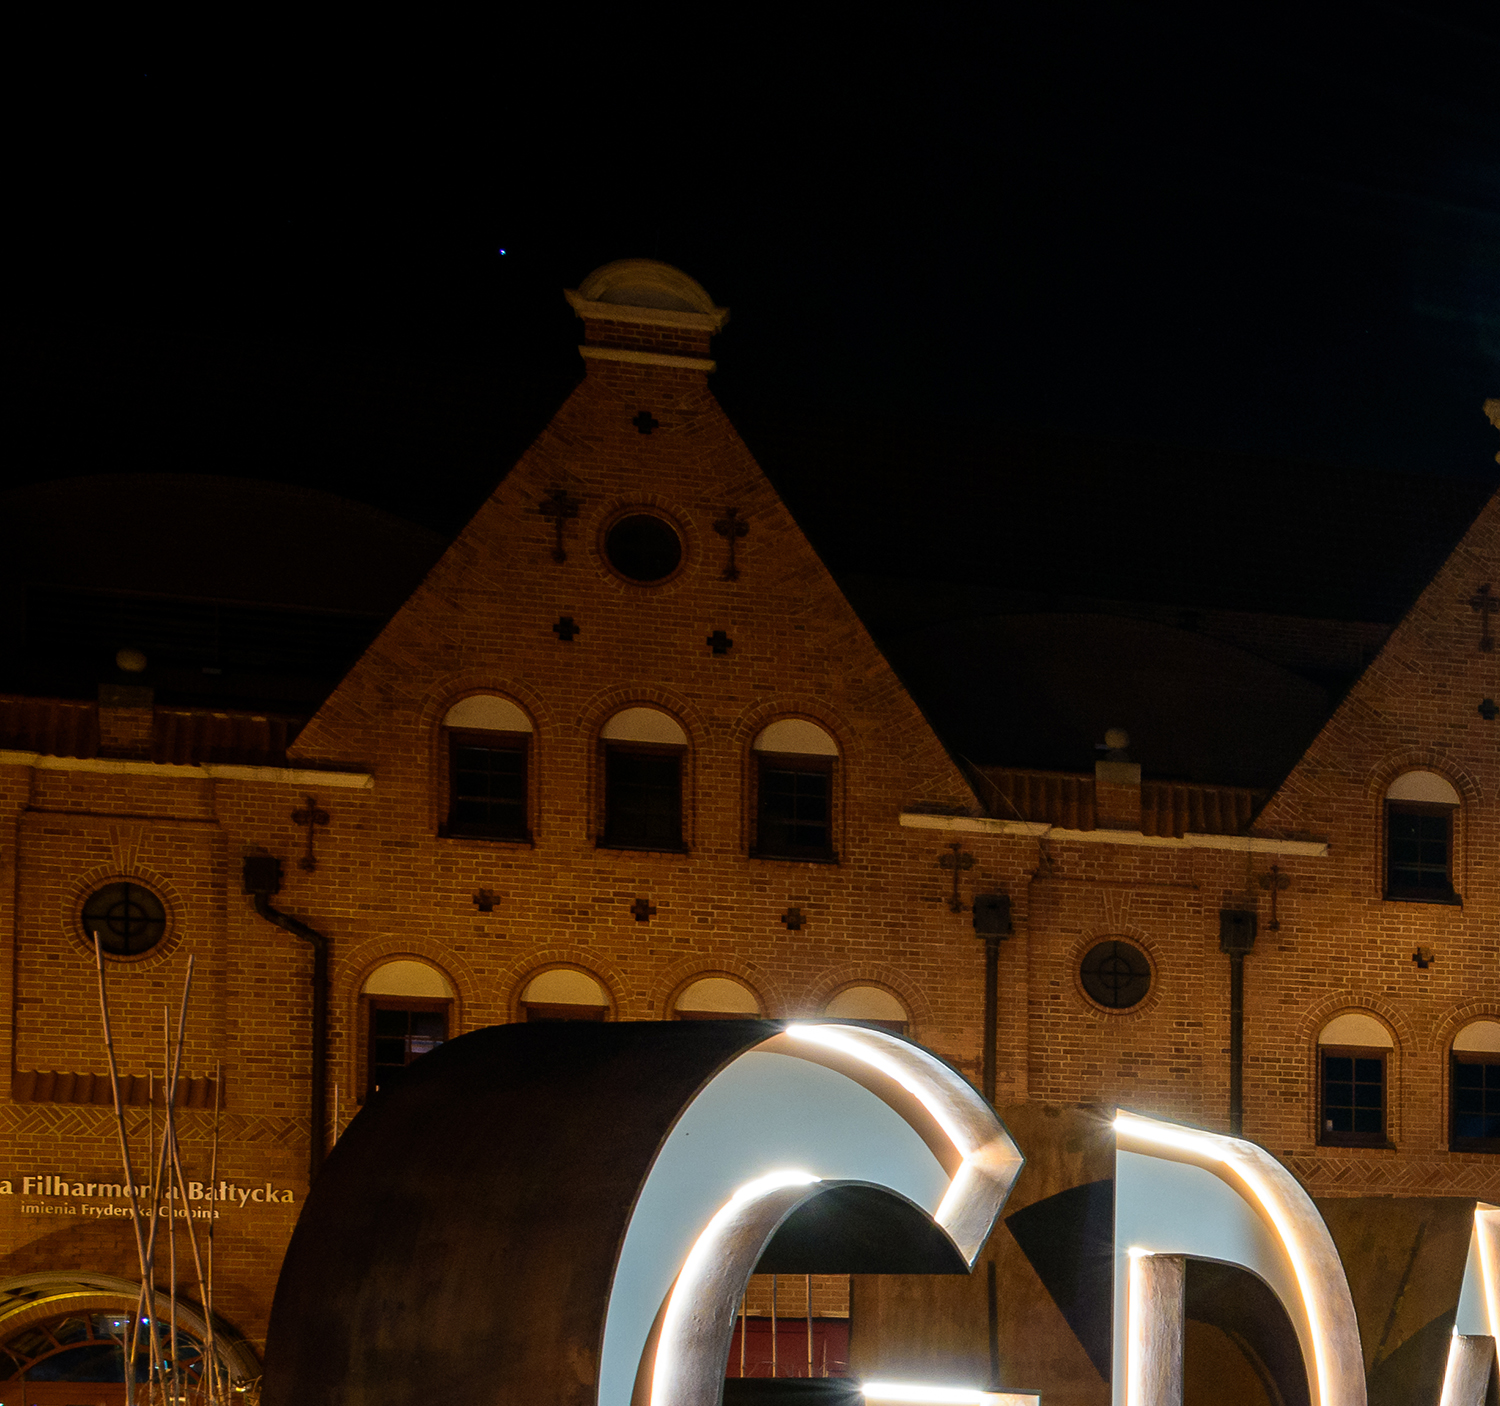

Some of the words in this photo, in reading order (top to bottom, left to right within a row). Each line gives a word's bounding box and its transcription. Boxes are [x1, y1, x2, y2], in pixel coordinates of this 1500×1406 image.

[23, 1175, 180, 1200] Filharmona
[188, 1181, 295, 1207] Bałtycka
[21, 1200, 77, 1215] imienia
[81, 1203, 153, 1219] Fryderyka
